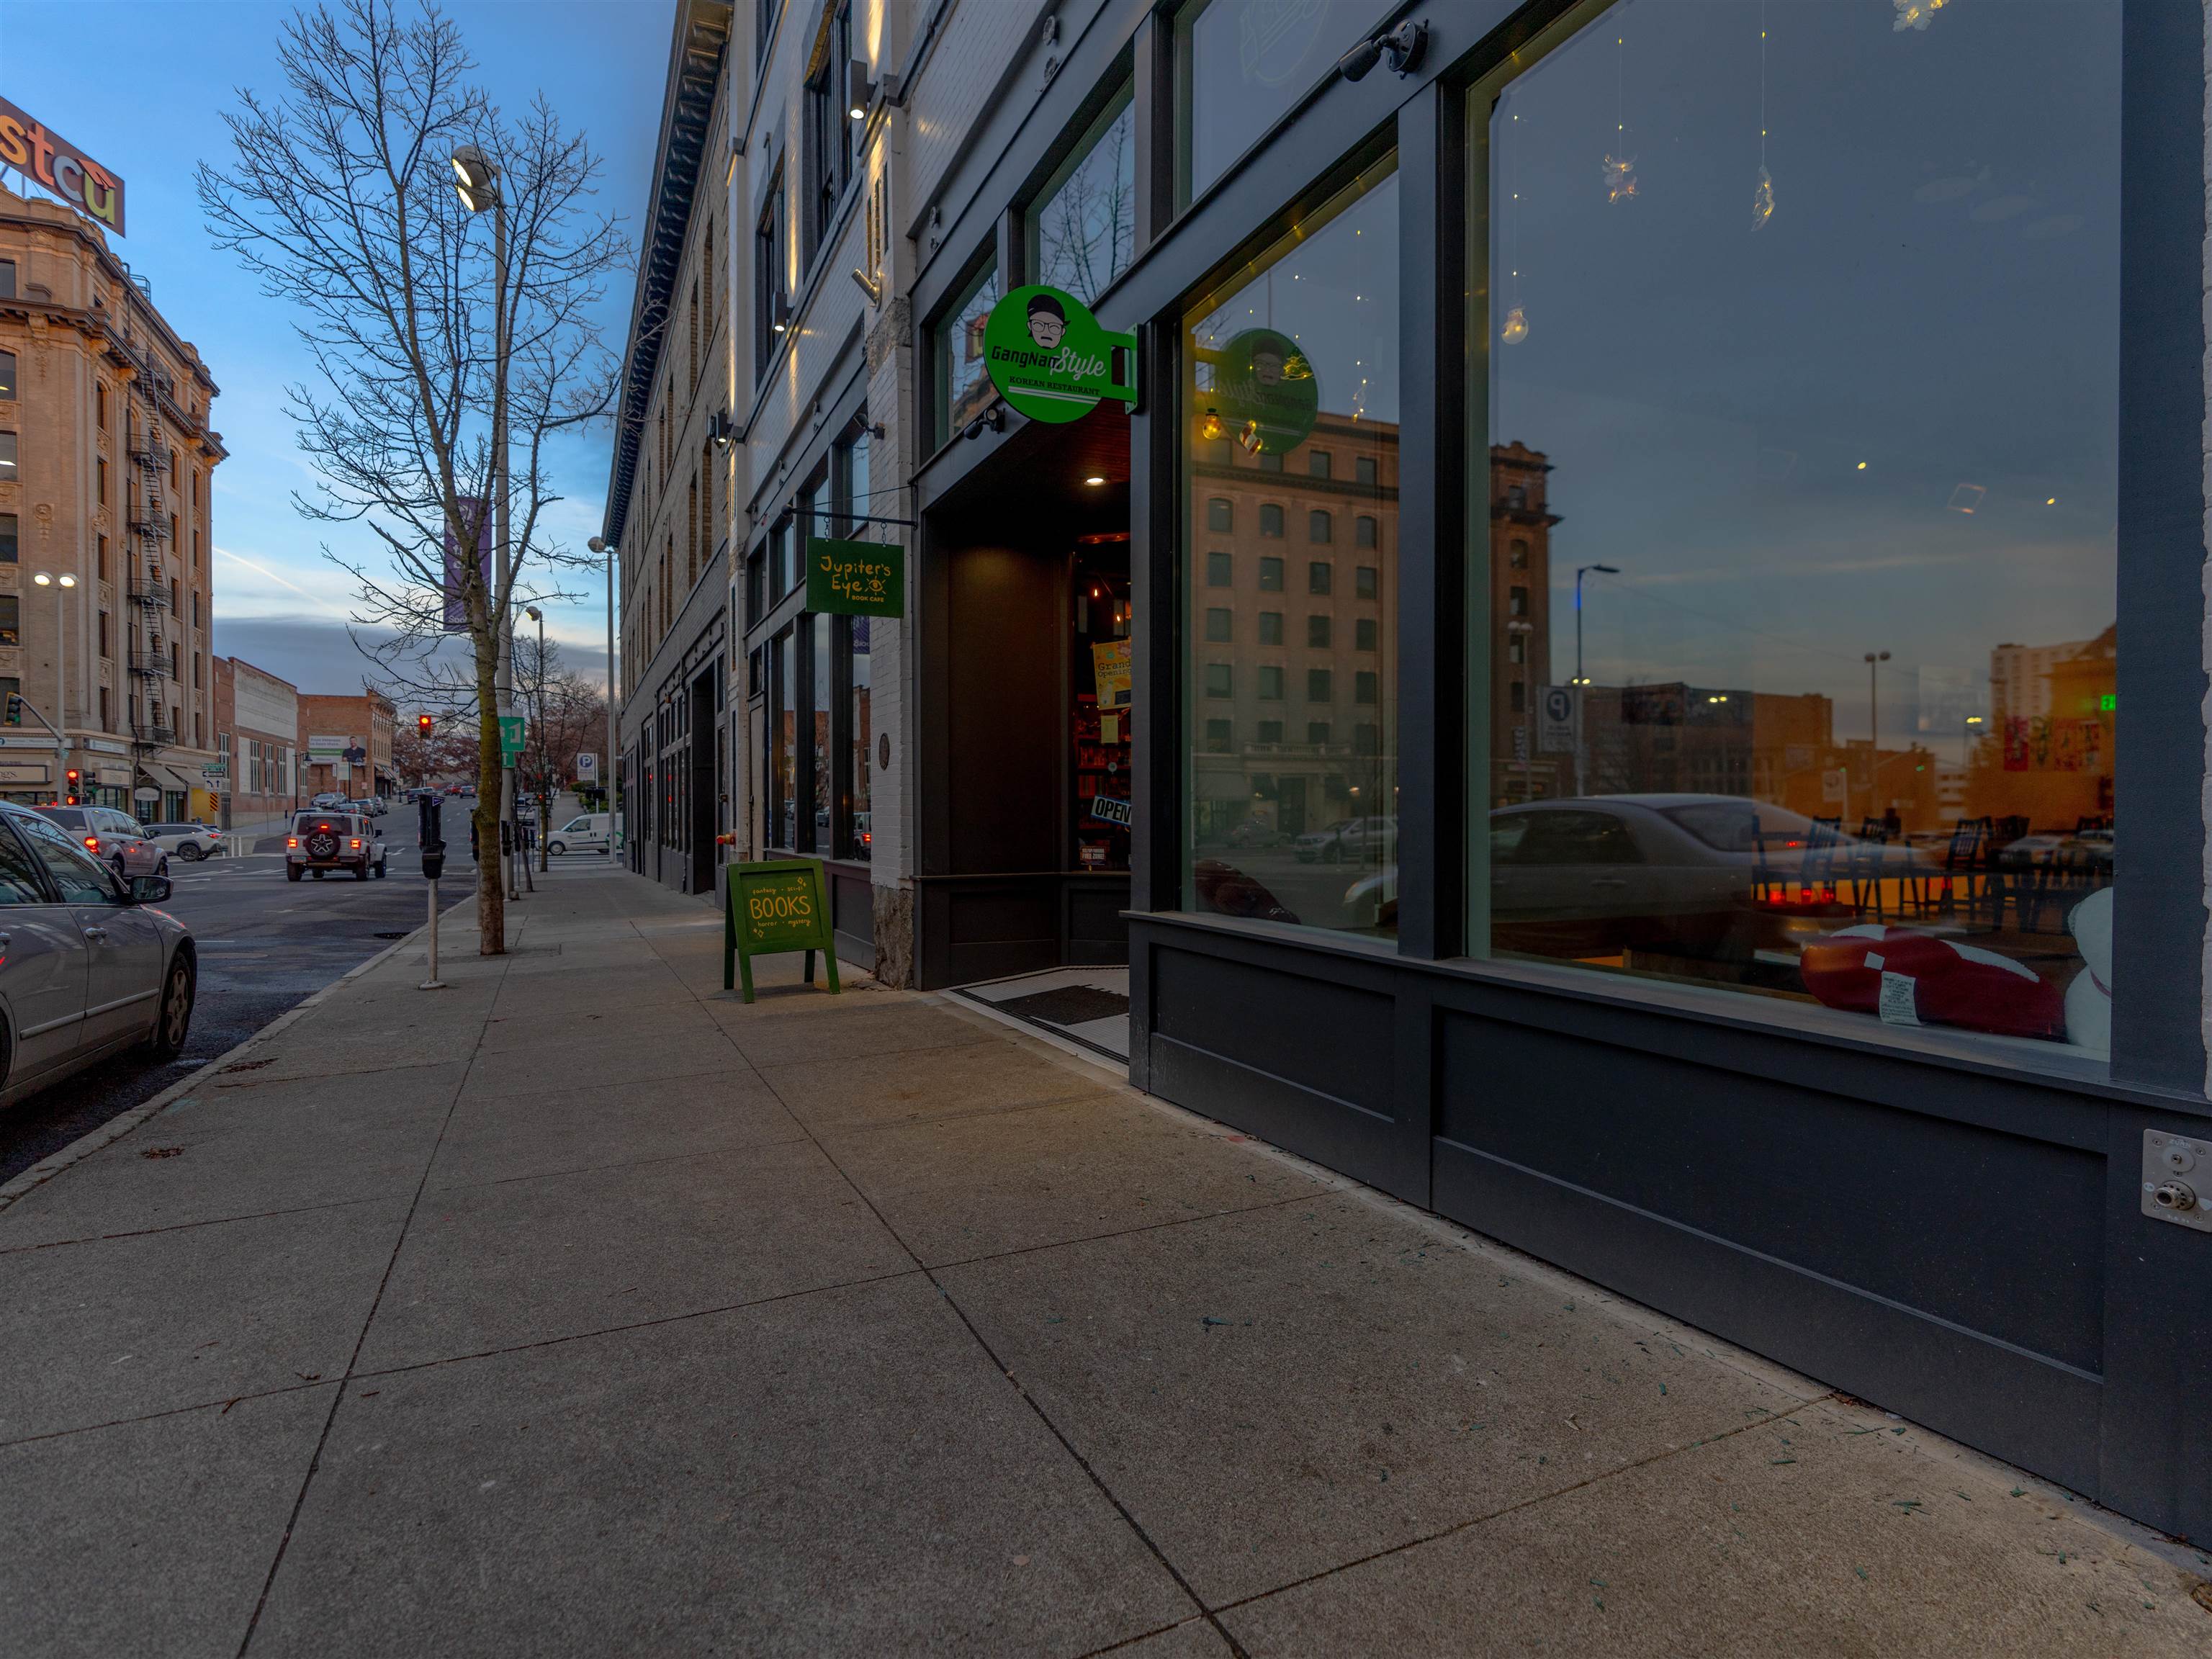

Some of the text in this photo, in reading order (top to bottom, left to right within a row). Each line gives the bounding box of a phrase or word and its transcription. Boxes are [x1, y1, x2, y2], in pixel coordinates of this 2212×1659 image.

[1049, 346, 1106, 381] Style
[1009, 376, 1101, 396] KOREAN RESTAURANT
[820, 555, 891, 580] Jupiter's
[831, 573, 863, 599] Eye
[1098, 659, 1130, 670] Grand
[1095, 798, 1130, 823] OPEN
[750, 895, 811, 920] BOOKS
[788, 919, 811, 927] mystery
